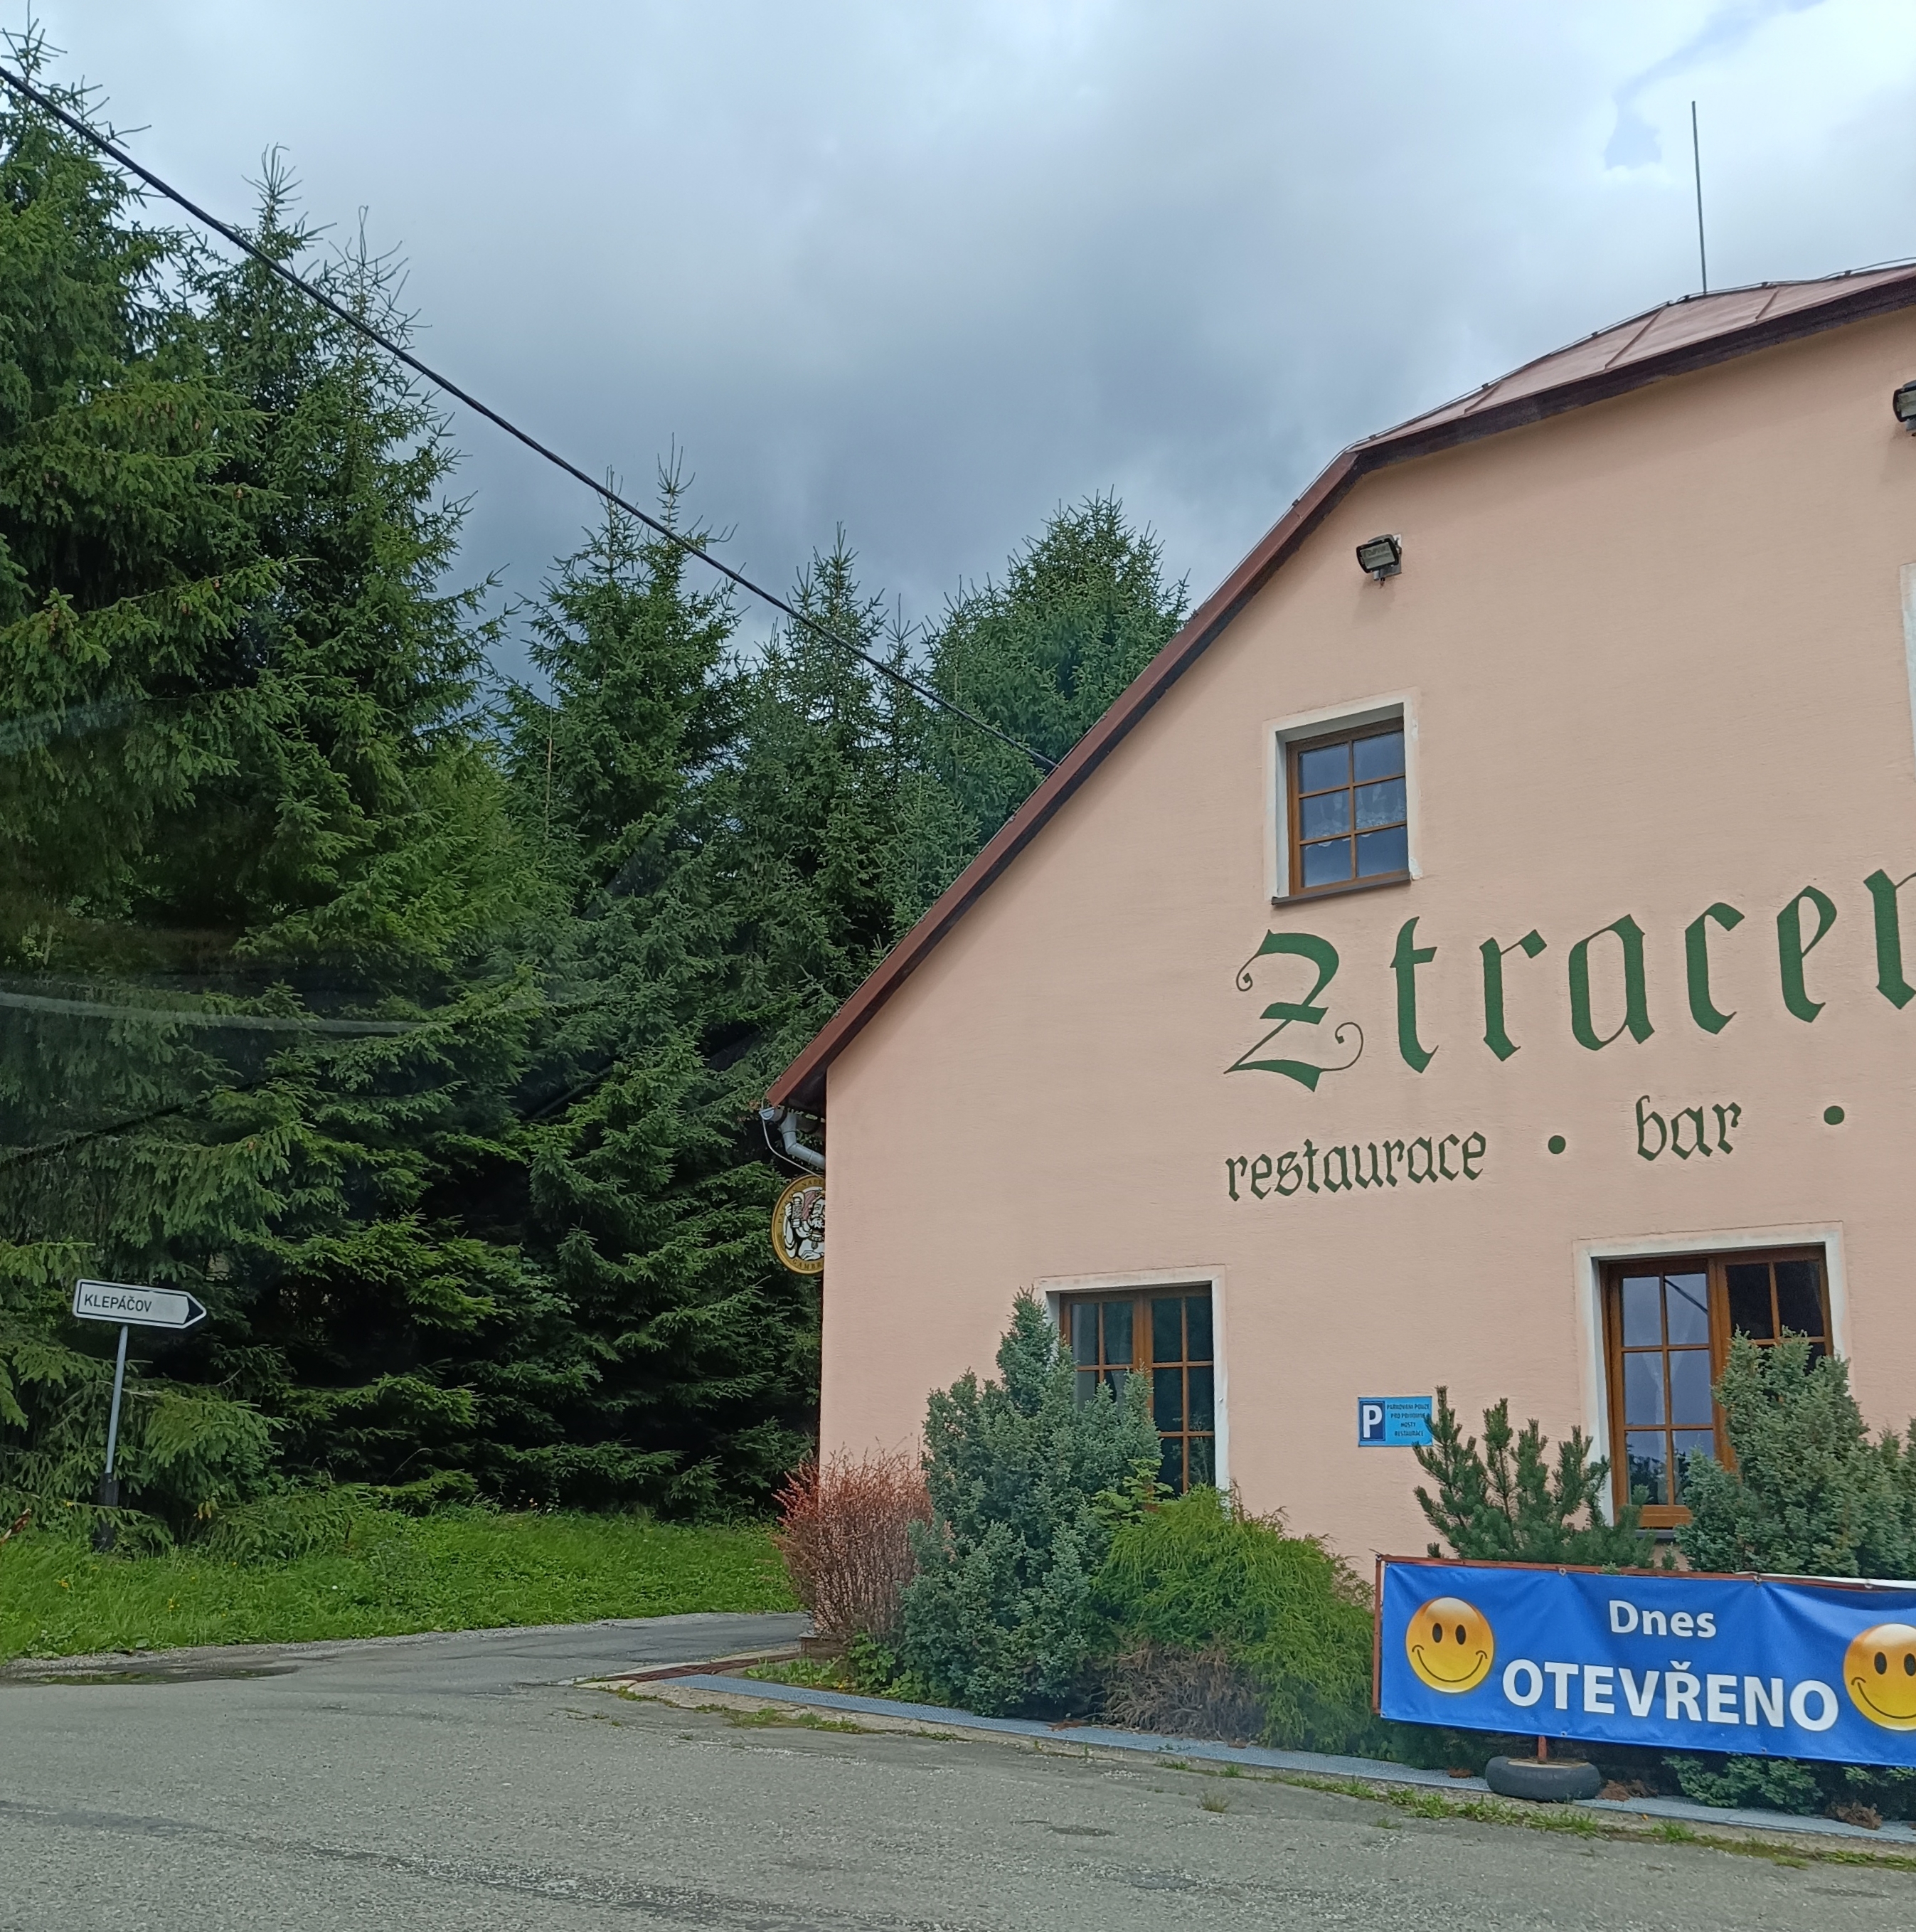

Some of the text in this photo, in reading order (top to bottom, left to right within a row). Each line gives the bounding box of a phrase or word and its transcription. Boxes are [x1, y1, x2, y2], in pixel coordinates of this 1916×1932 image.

[1225, 1095, 1742, 1201] restaurace bar
[84, 1293, 152, 1312] KLEPÁČOV
[1363, 1405, 1383, 1438] P
[1609, 1600, 1717, 1638] Dnes
[1503, 1659, 1838, 1731] OTEVŘENO
